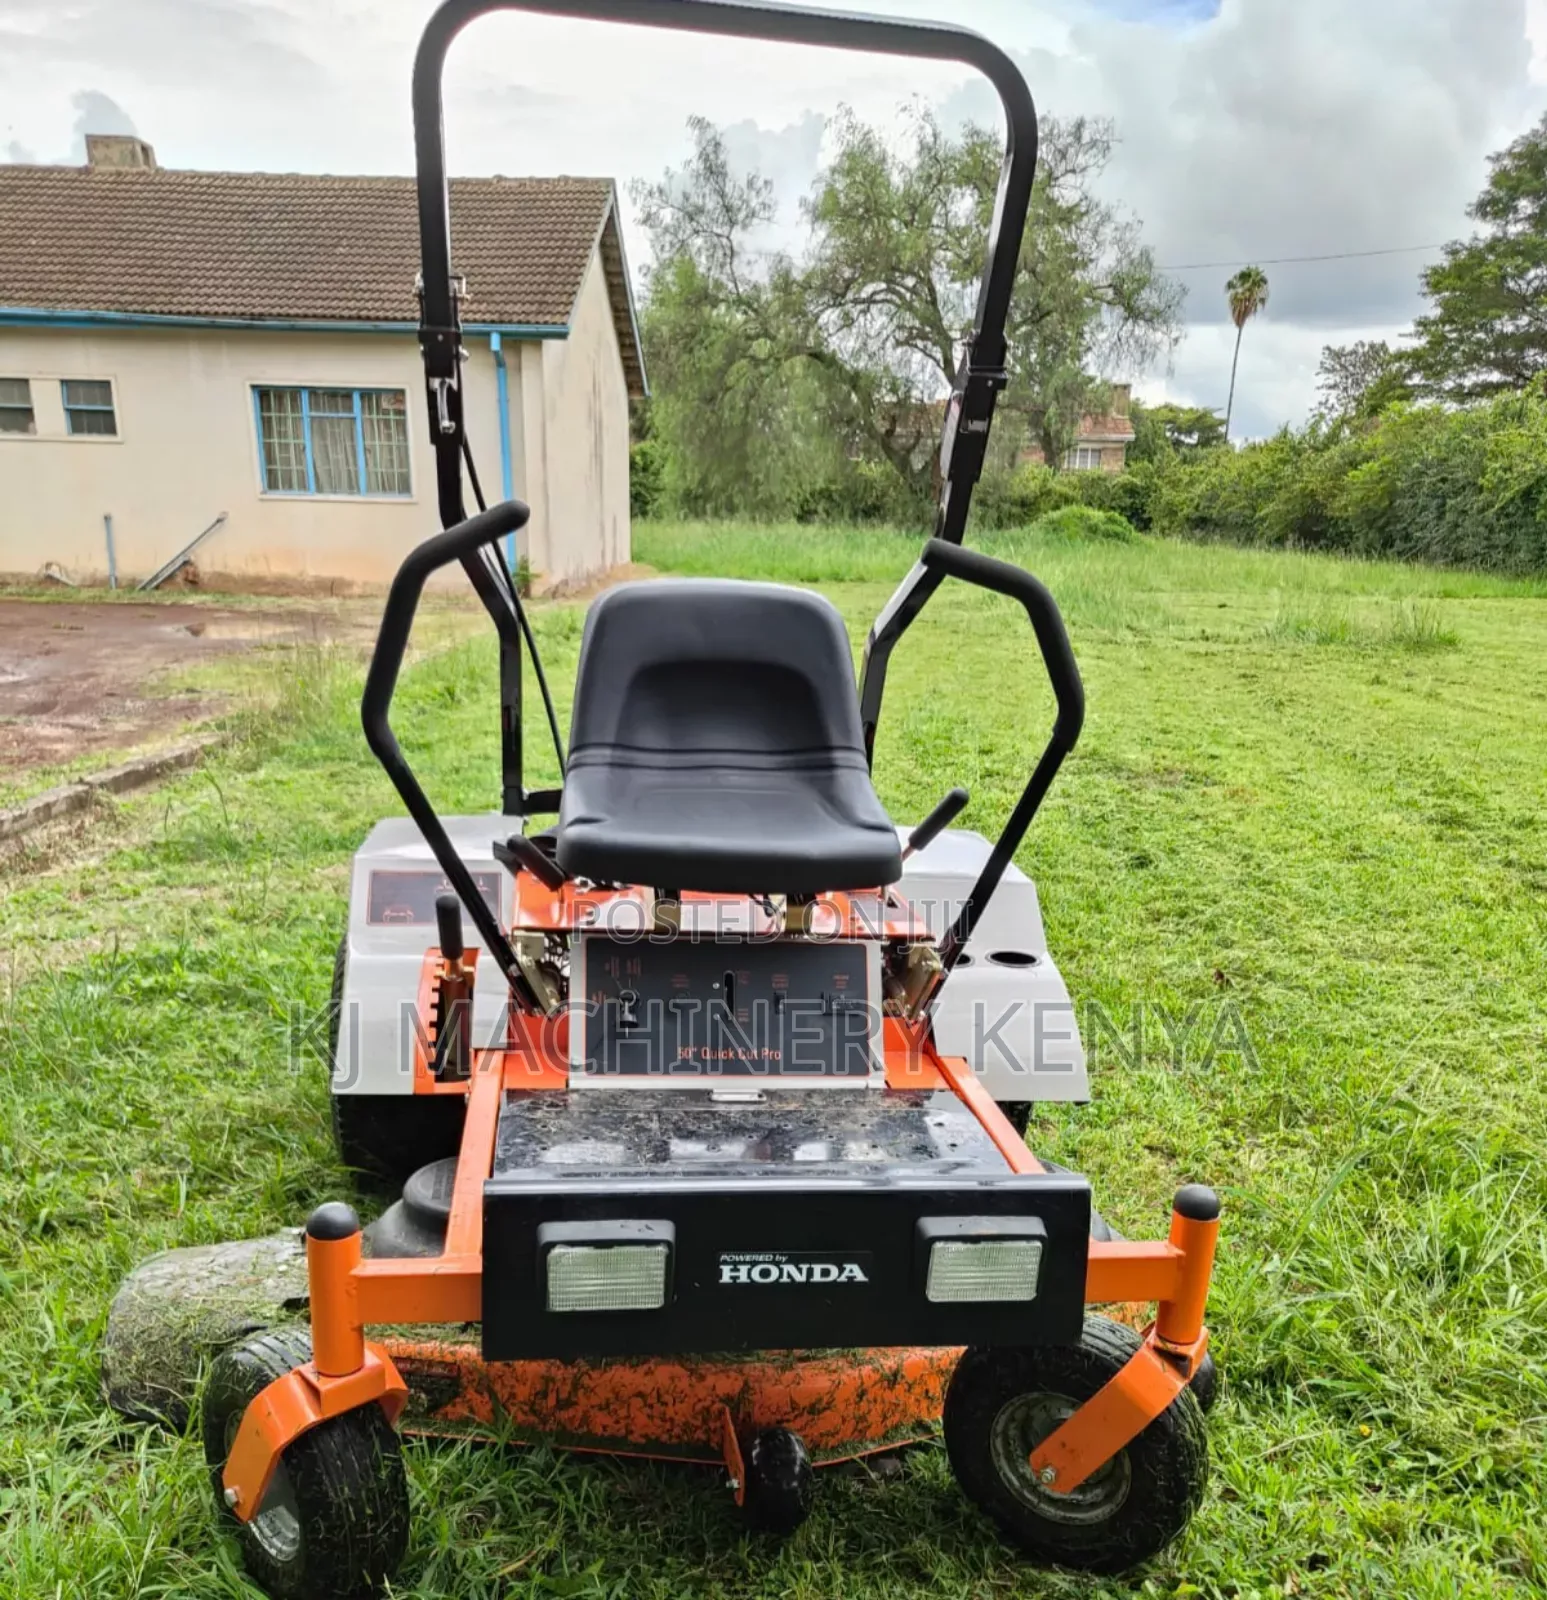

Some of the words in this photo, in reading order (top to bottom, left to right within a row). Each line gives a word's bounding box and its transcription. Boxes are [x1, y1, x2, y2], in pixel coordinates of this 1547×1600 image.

[701, 1046, 735, 1061] Quick
[738, 1046, 758, 1061] Cut
[761, 1047, 781, 1060] Pro
[720, 1254, 773, 1262] POWERED
[775, 1254, 788, 1263] by
[719, 1264, 869, 1283] HONDA
